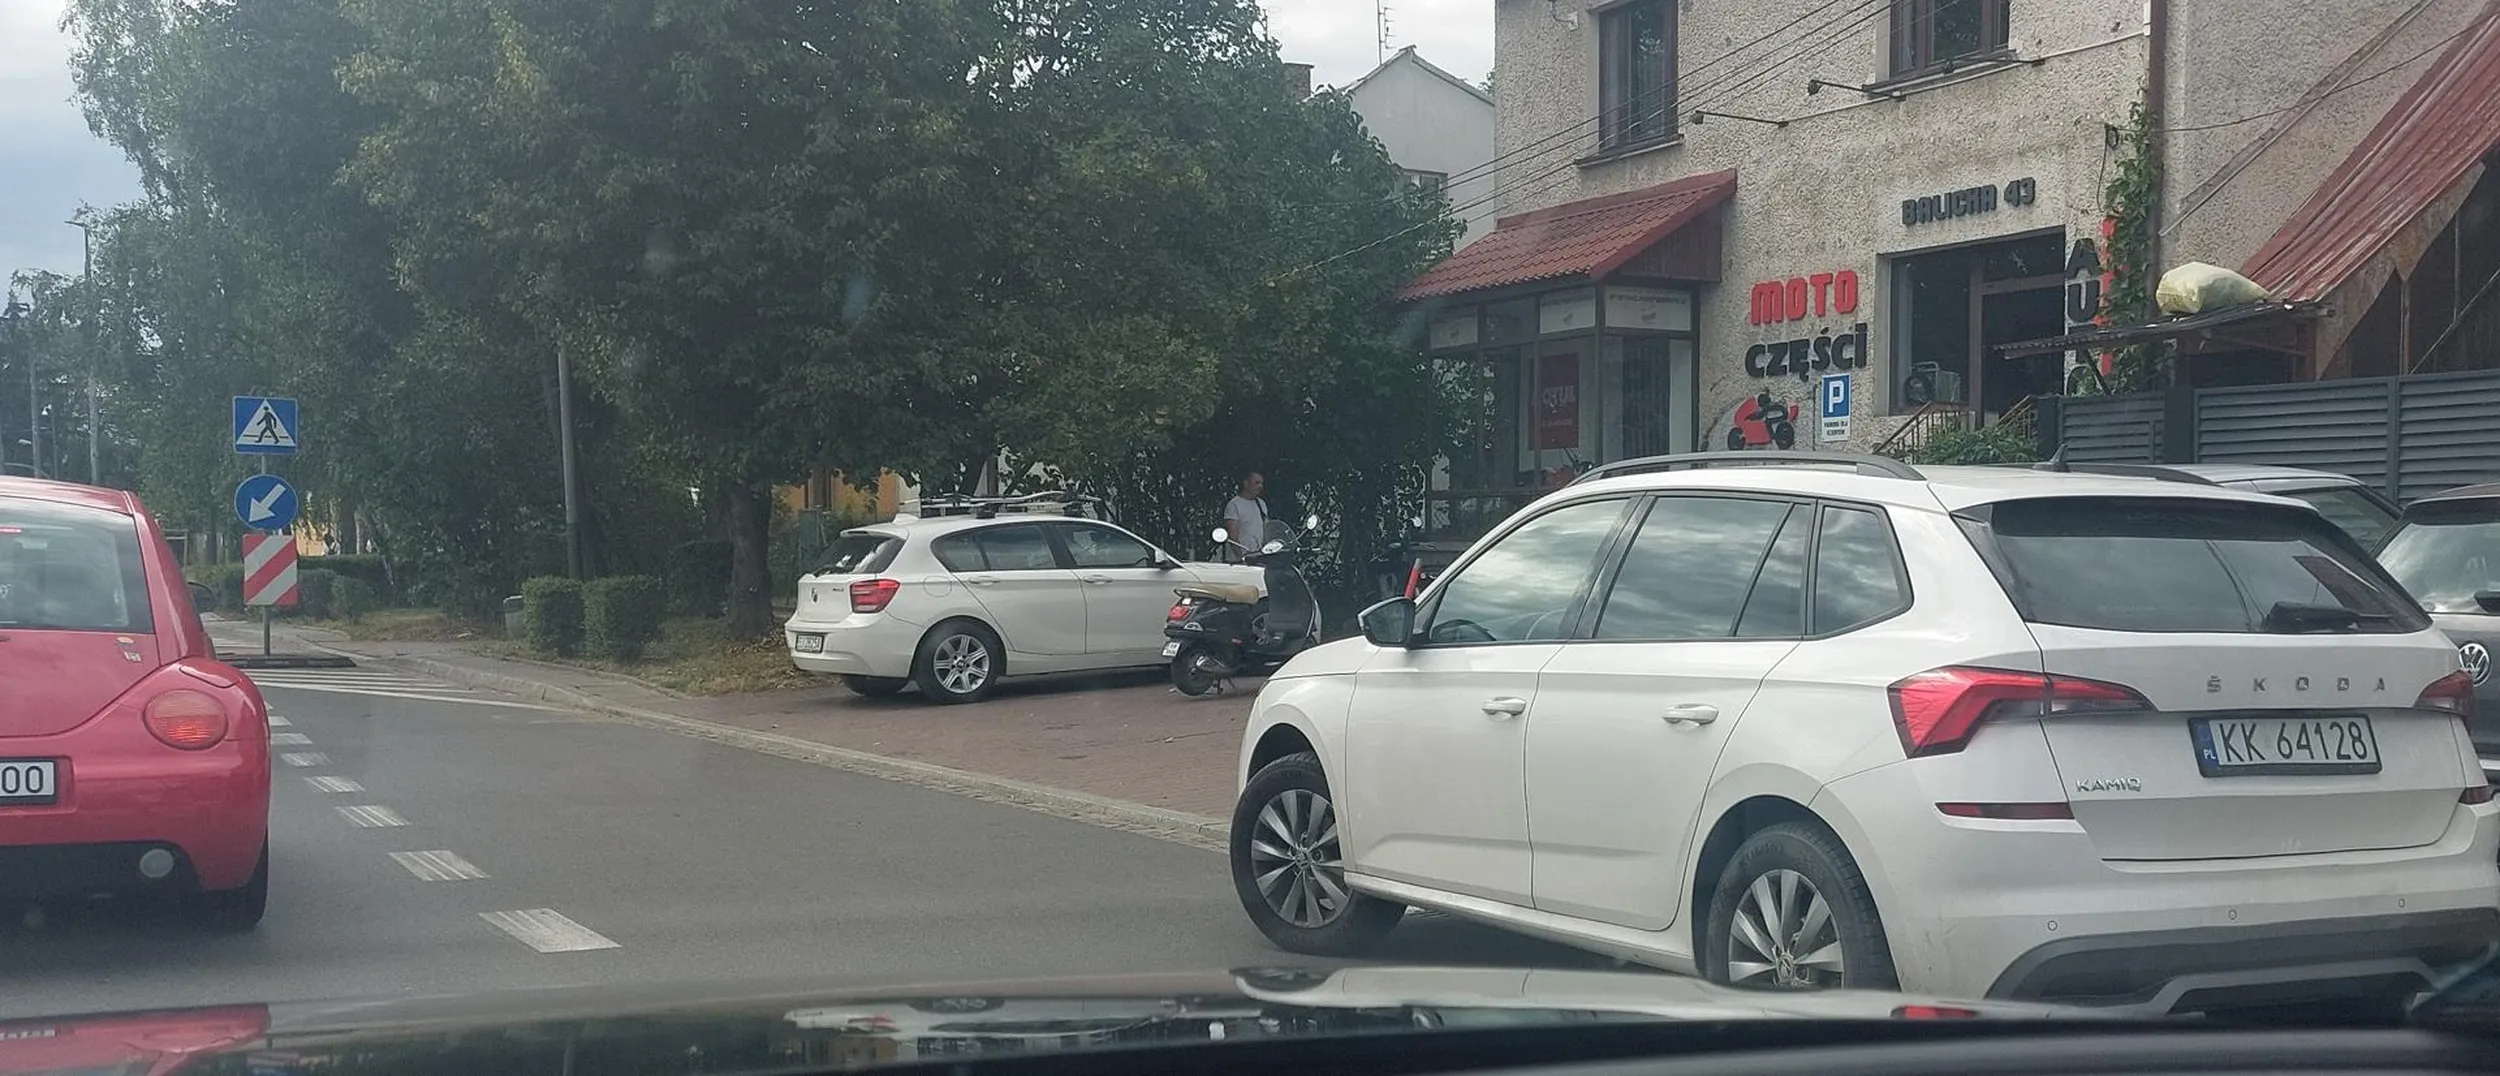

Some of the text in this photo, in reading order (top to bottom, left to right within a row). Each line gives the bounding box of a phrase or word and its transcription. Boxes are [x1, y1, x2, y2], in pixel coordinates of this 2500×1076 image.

[2004, 177, 2036, 206] 43
[1750, 270, 1858, 326] MOTO
[1828, 380, 1845, 414] P
[2203, 749, 2217, 761] PL
[2218, 721, 2369, 762] KK 64128
[2075, 777, 2143, 794] KAMIQ
